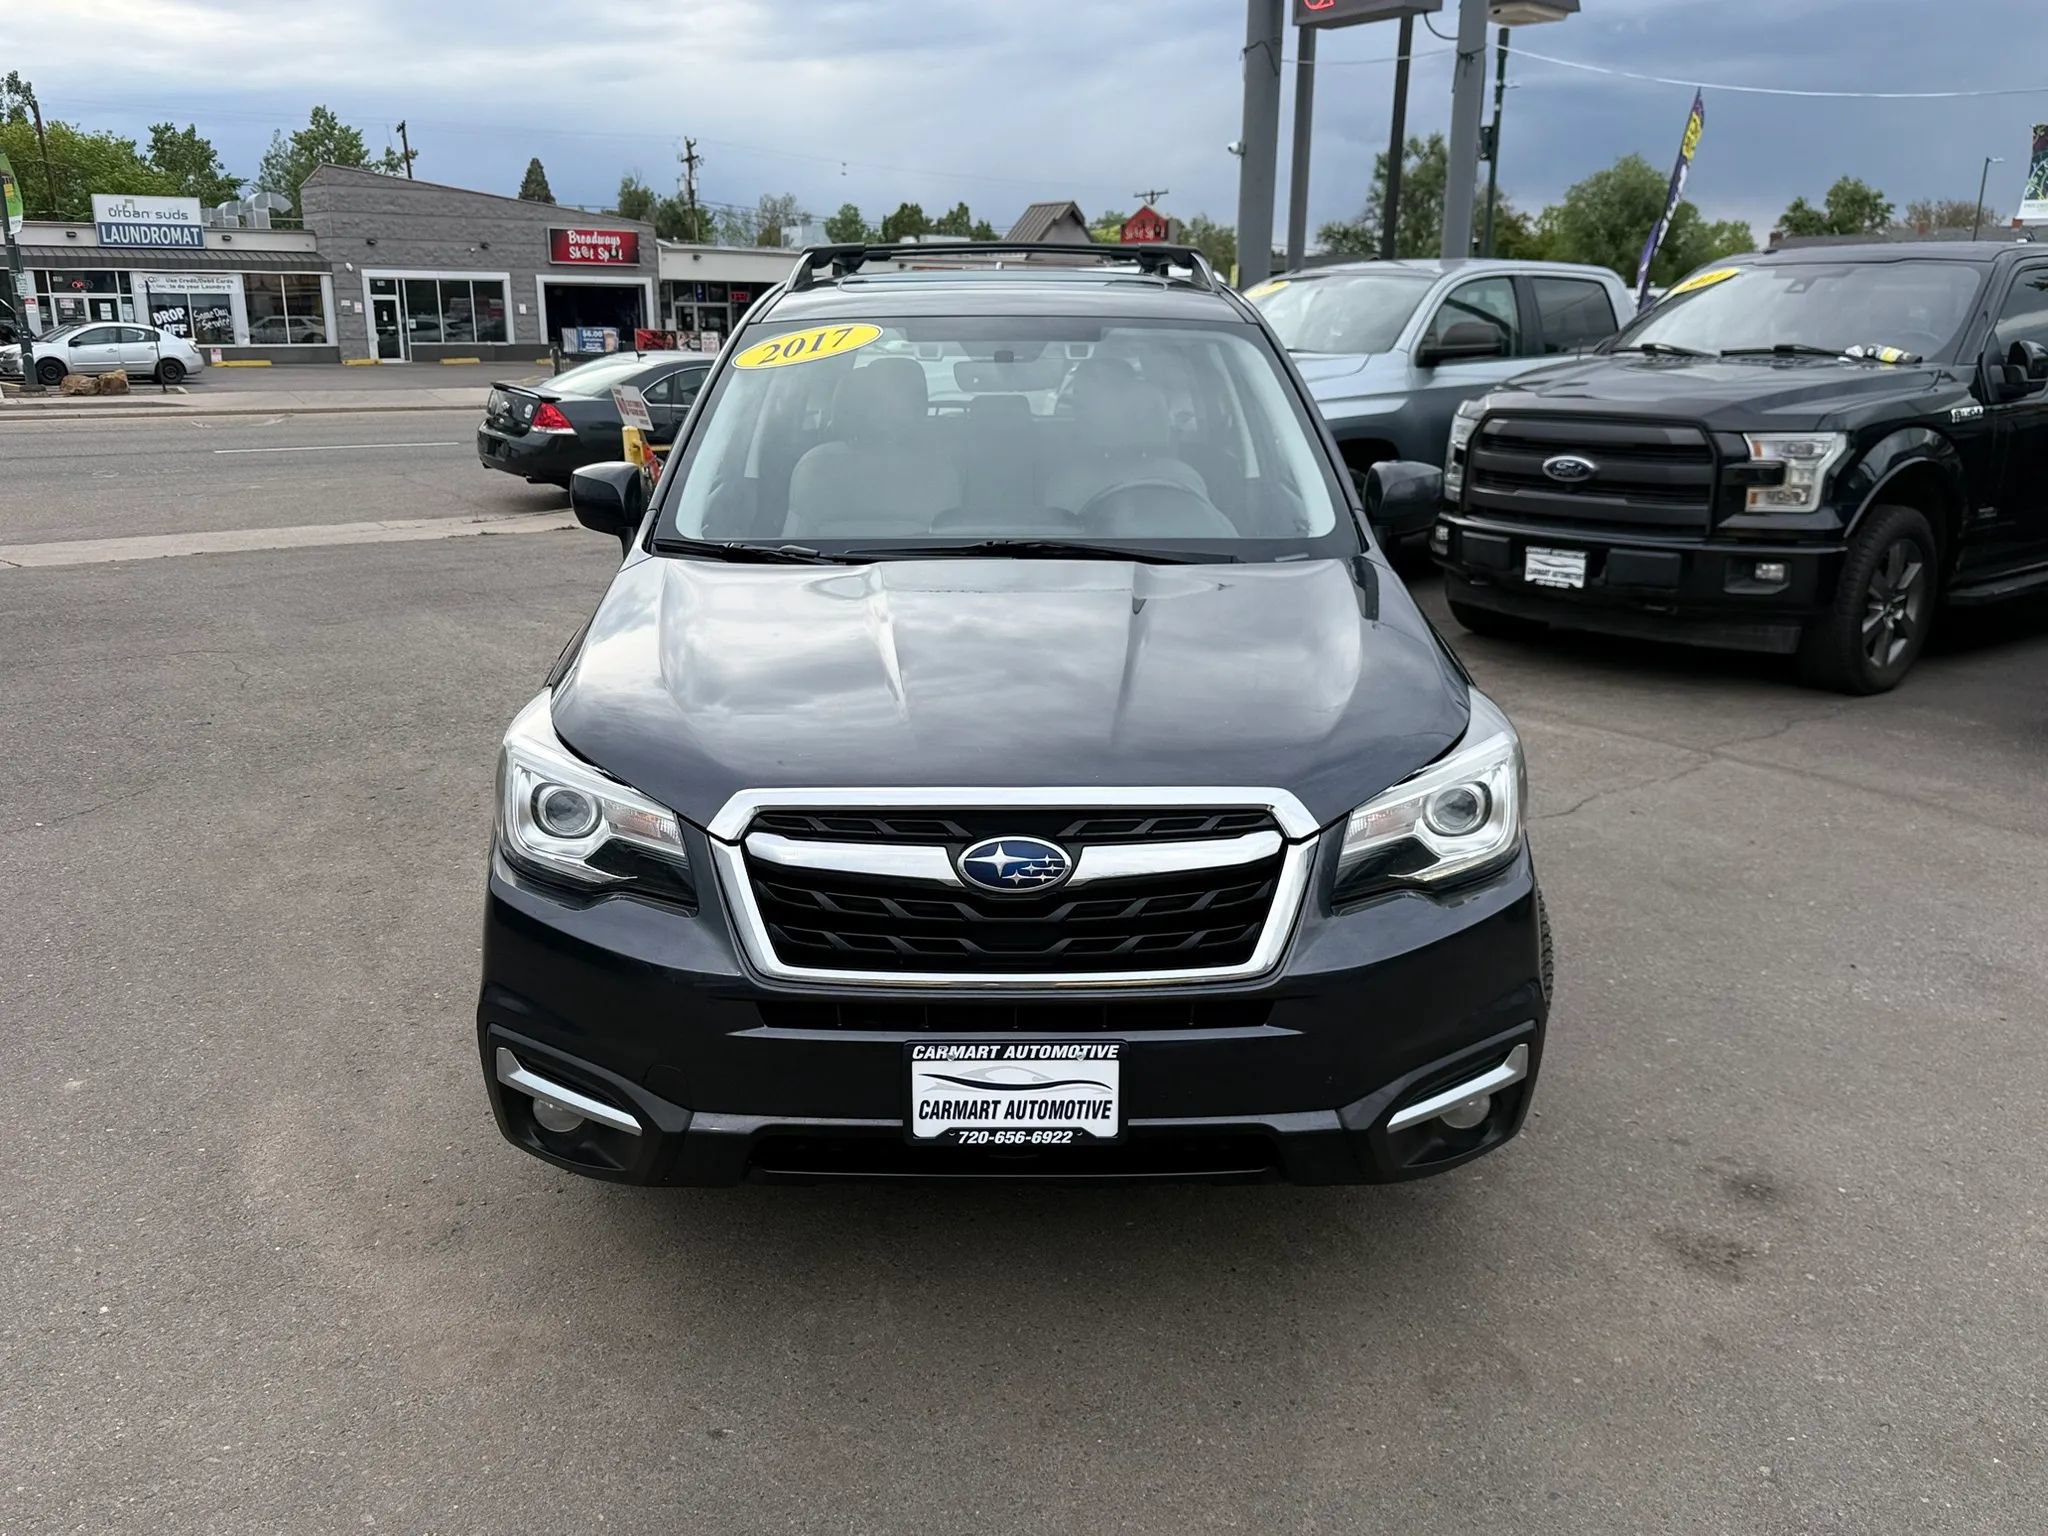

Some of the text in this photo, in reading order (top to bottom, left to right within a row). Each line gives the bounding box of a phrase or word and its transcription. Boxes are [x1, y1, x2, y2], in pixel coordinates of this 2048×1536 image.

[155, 209, 189, 220] suds
[101, 225, 200, 245] LAUNDROMAT
[153, 307, 185, 325] DROP
[193, 309, 214, 321] Same
[163, 324, 188, 336] OFF
[202, 318, 231, 331] Service
[757, 327, 854, 365] 2017
[912, 1044, 1119, 1060] CARMART AUTOMOTIVE
[918, 1099, 1113, 1121] CARMART AUTOMOTIVE
[957, 1131, 1074, 1144] 720-656-6922
